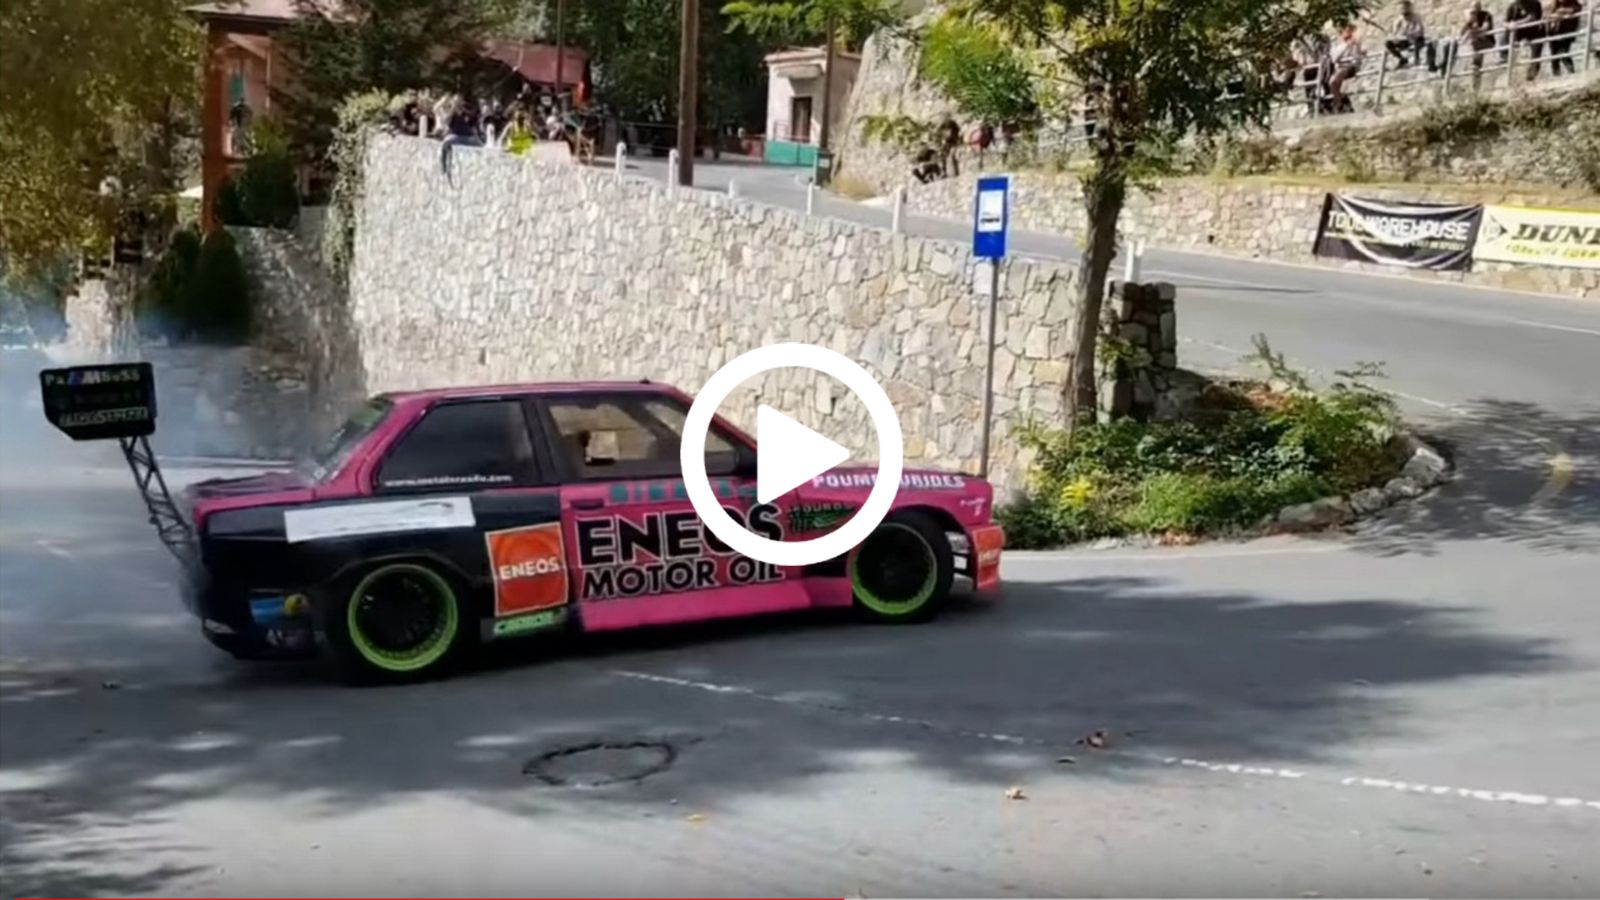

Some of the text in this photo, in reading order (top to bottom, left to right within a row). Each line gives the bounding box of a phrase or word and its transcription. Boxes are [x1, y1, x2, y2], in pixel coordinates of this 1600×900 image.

[499, 556, 560, 580] ENEOS
[582, 555, 785, 600] MOTOR OIL
